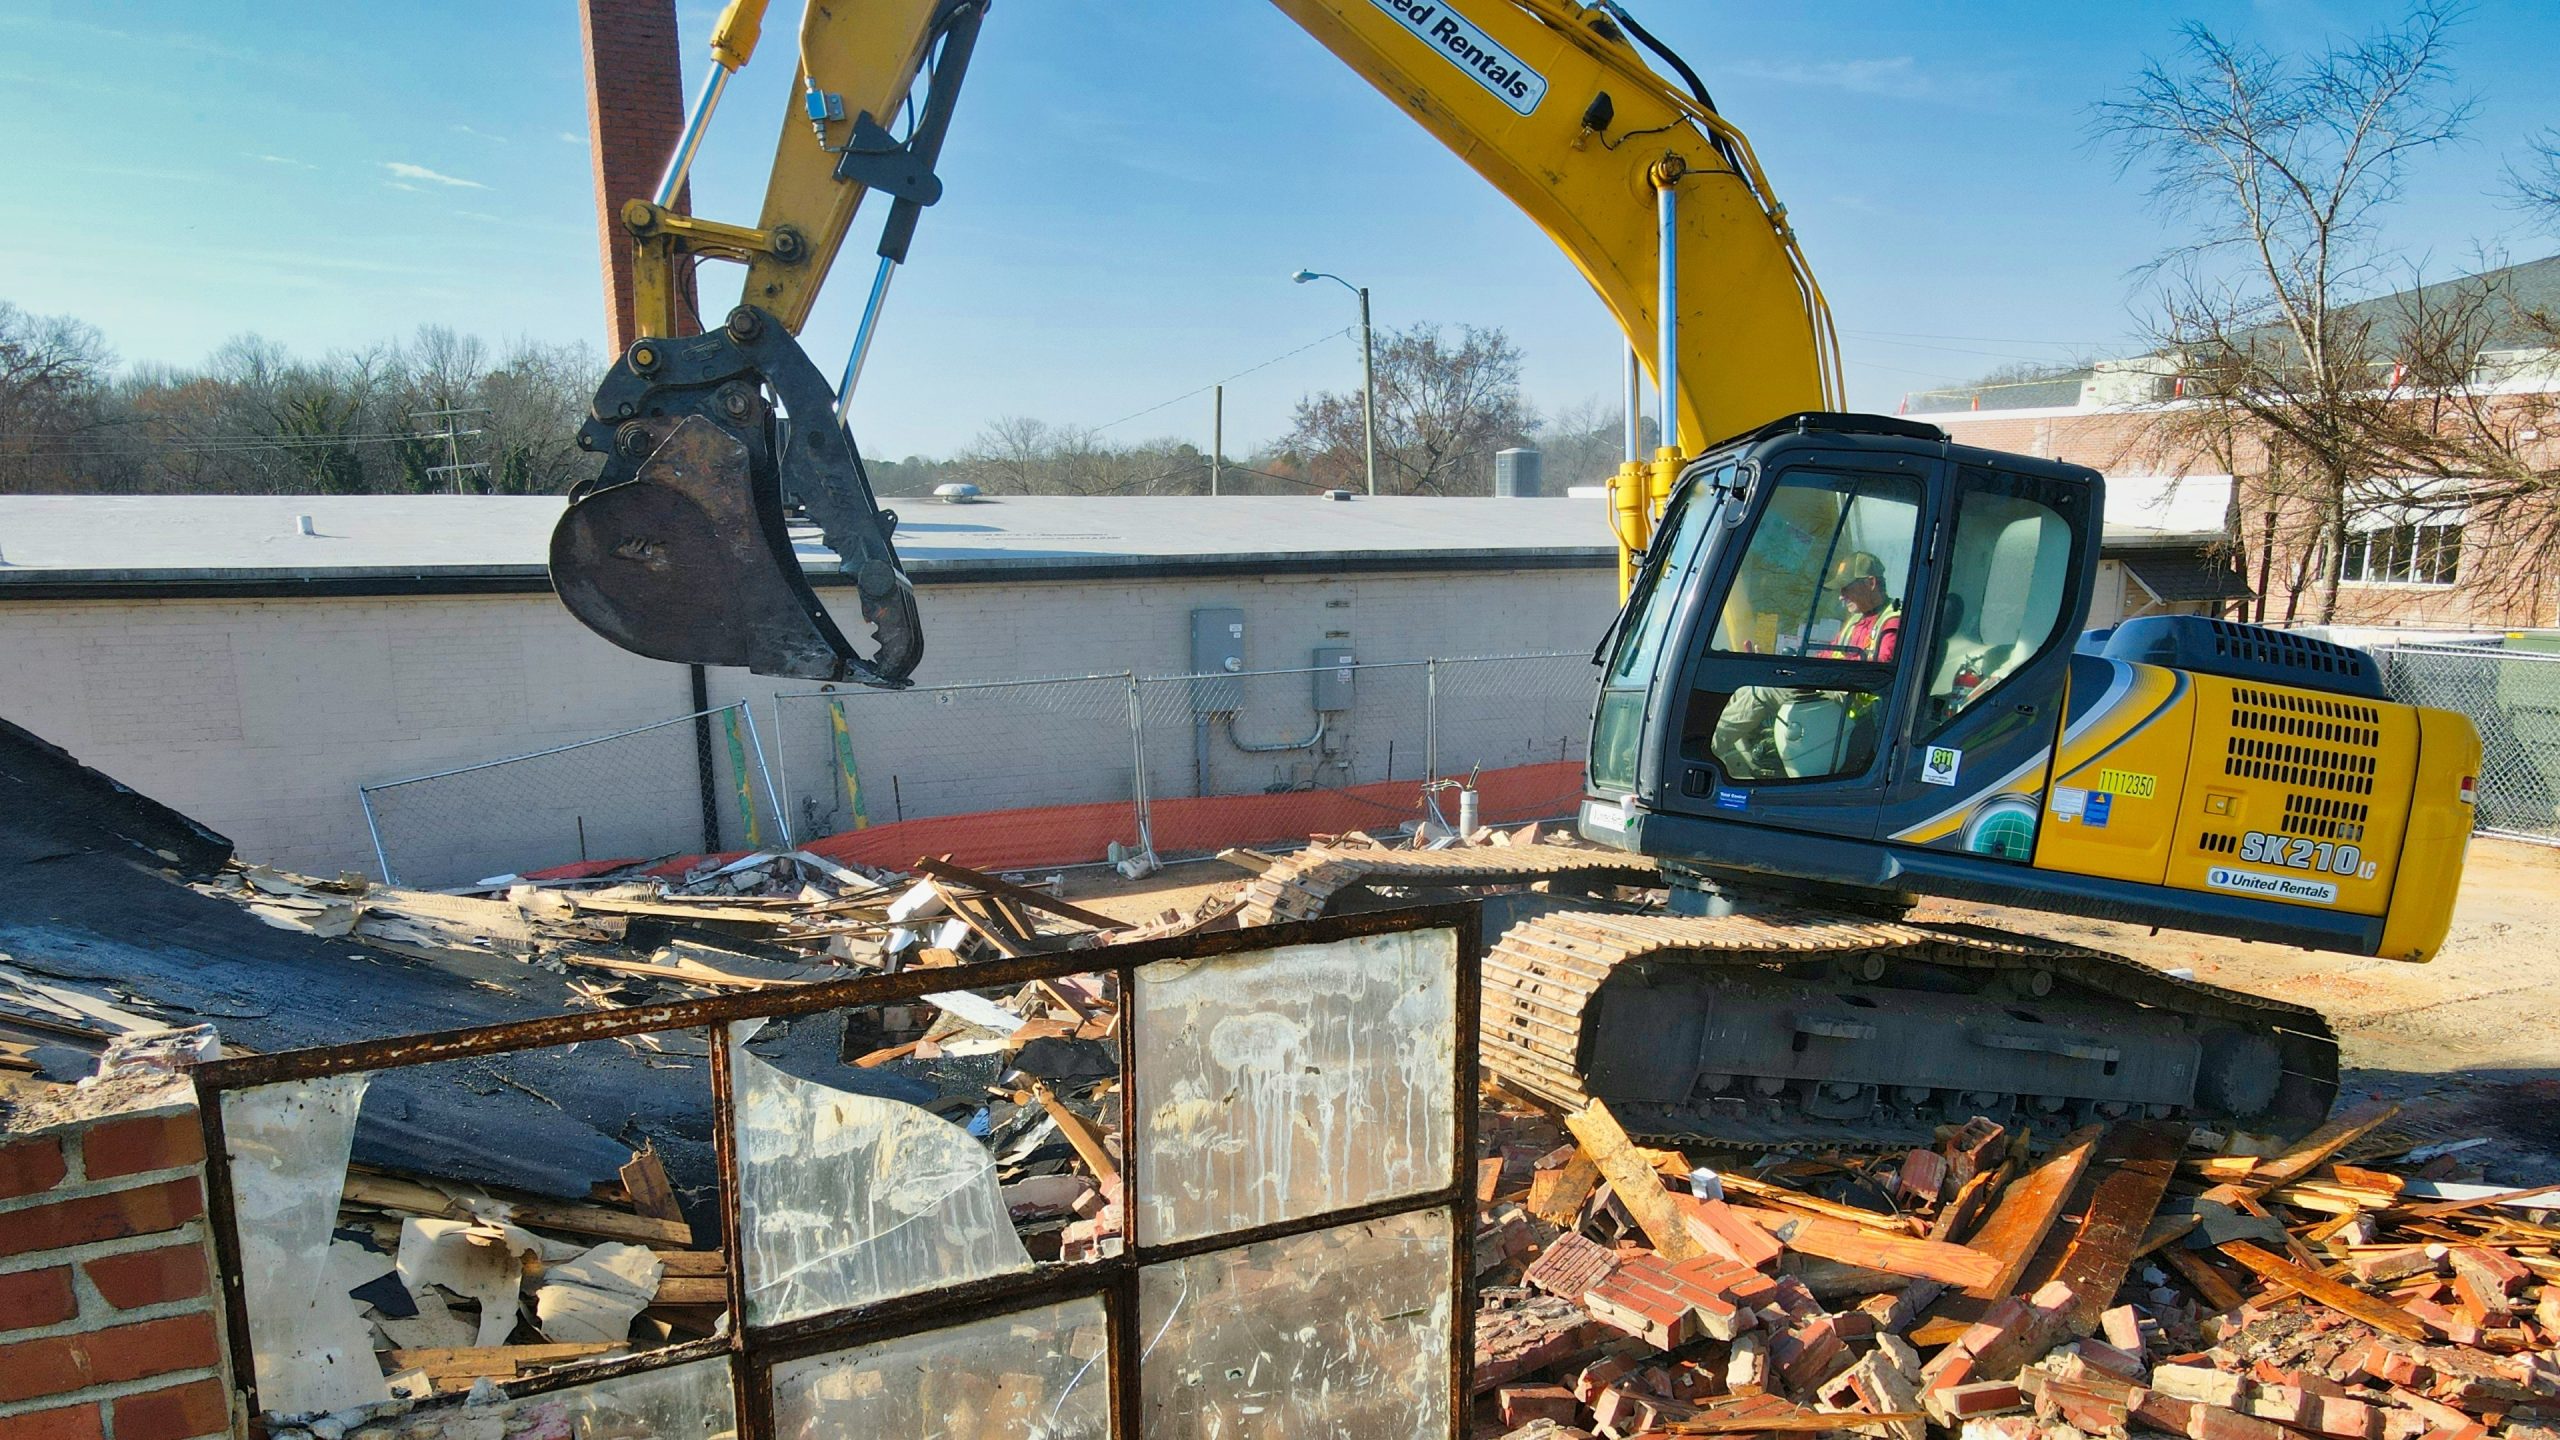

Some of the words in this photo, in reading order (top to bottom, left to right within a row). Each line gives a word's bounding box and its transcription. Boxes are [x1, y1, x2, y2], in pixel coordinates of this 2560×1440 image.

[1384, 0, 1436, 26] ed
[1430, 16, 1528, 98] Rentals
[1932, 748, 1953, 766] 811
[2101, 771, 2154, 797] 11112350
[2231, 873, 2278, 891] United
[2279, 881, 2329, 898] Rentals
